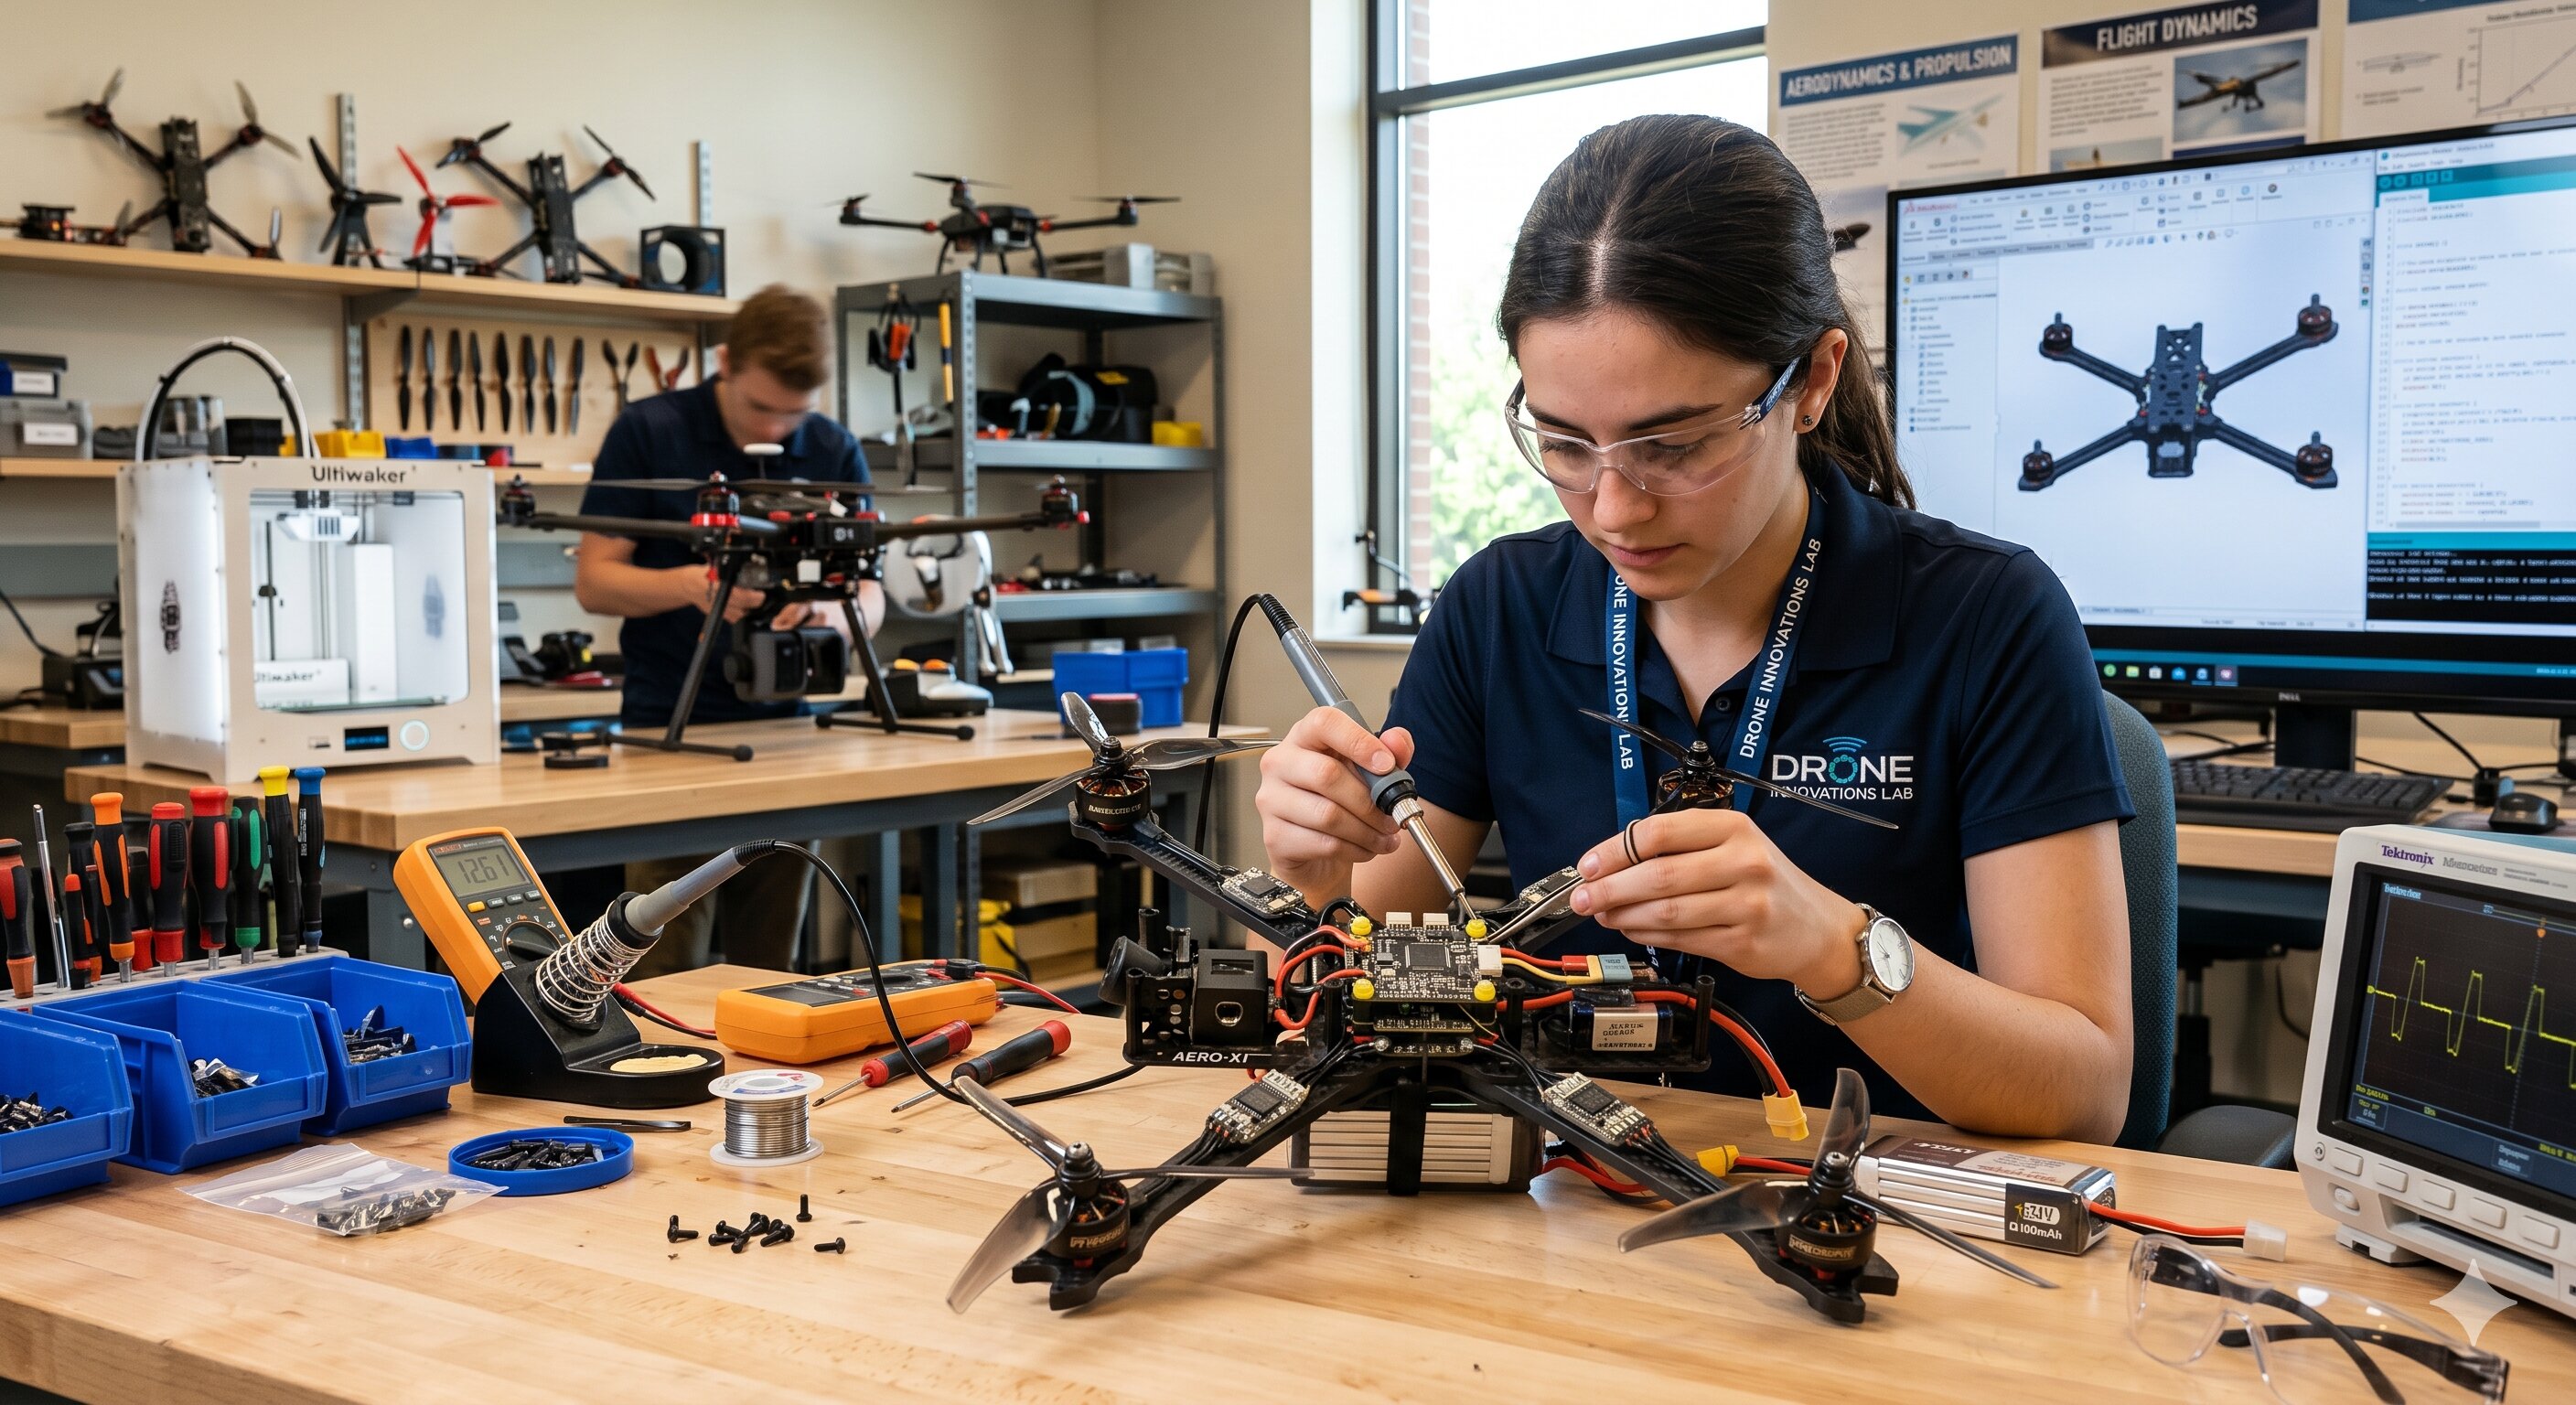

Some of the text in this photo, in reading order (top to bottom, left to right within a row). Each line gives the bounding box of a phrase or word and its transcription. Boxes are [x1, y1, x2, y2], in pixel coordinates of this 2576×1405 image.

[2097, 5, 2258, 51] FLIGHT DYNAMICS
[1785, 45, 2012, 99] AERODYNAMICS & PROPULSION
[1614, 574, 1627, 608] ONE
[1739, 538, 1821, 758] DRONE INNOVATIONS LAB
[1618, 734, 1634, 769] LAB
[1772, 754, 1915, 784] DRONE
[1882, 787, 1914, 800] LAB
[2381, 845, 2435, 868] Tektronix
